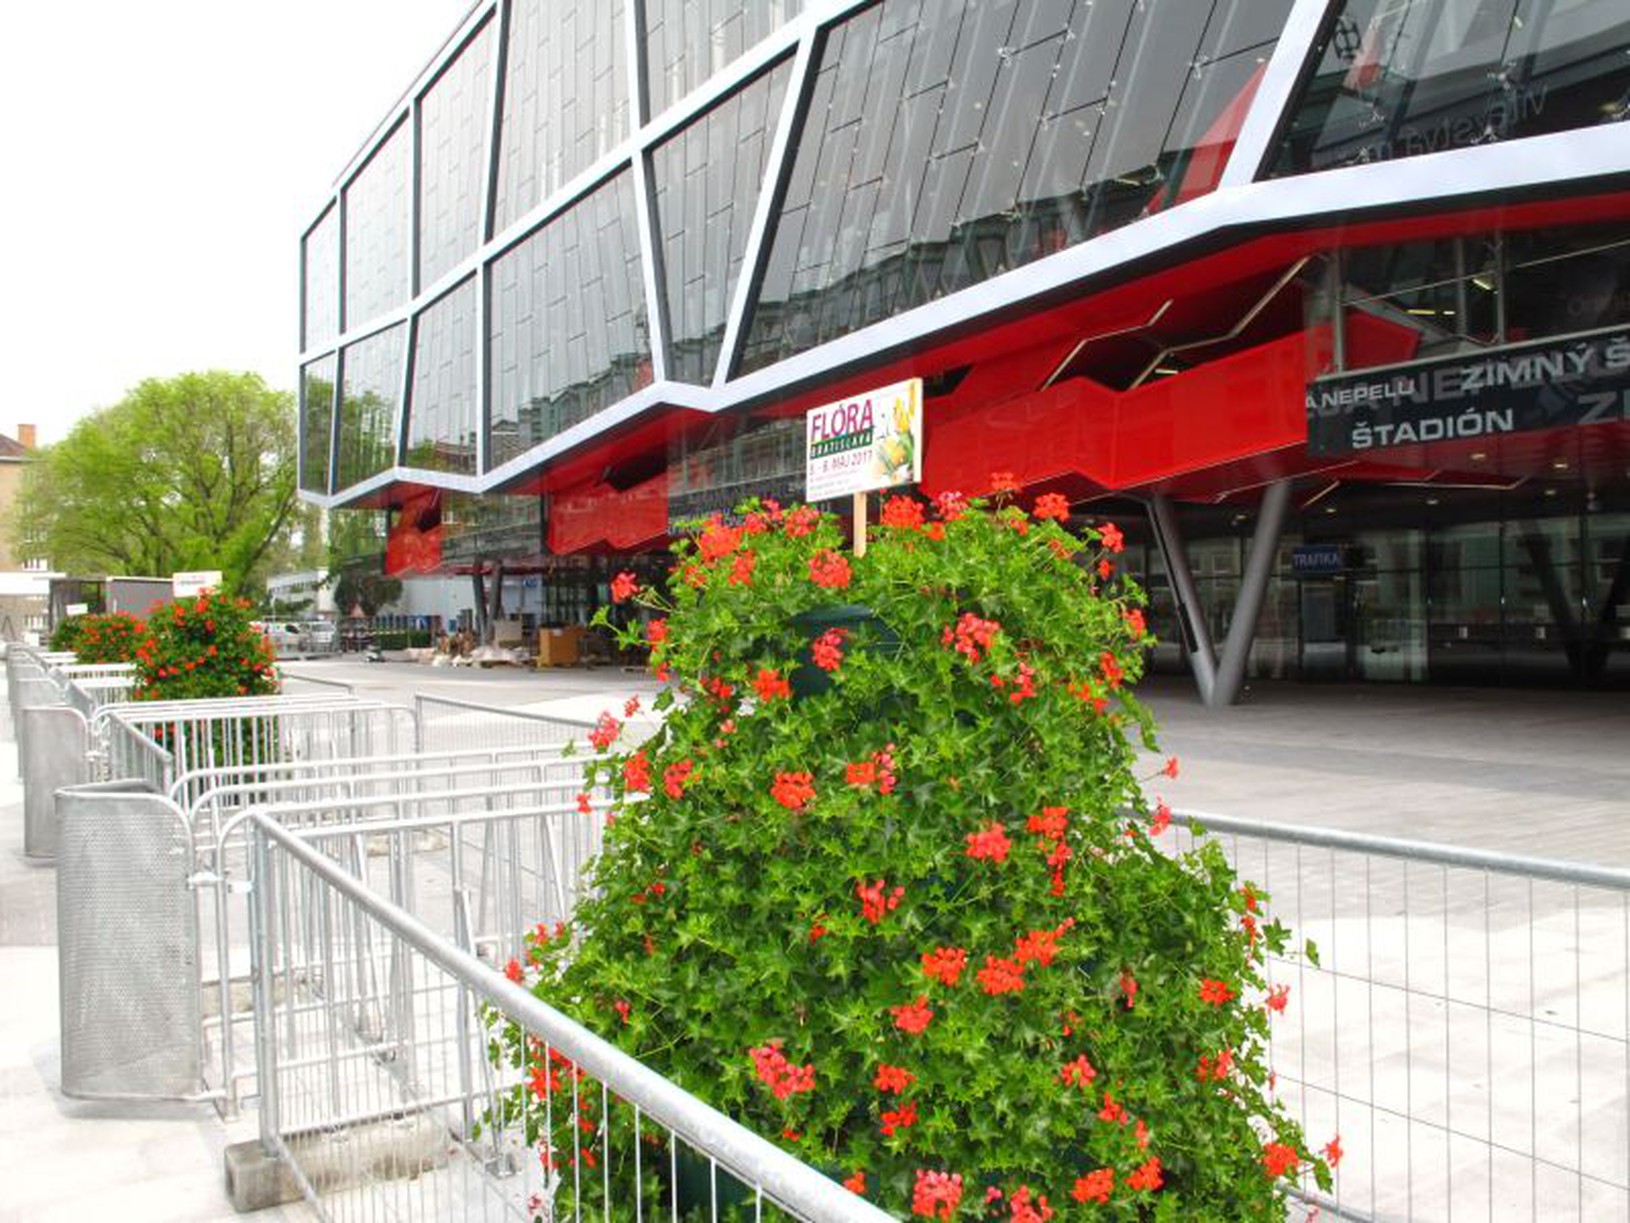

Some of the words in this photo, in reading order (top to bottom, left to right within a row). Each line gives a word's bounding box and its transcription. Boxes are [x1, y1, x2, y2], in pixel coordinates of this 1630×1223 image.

[1461, 342, 1595, 390] ZIMNÝ
[1321, 379, 1415, 408] NEPELU
[1352, 407, 1513, 449] ŠTADIÓN
